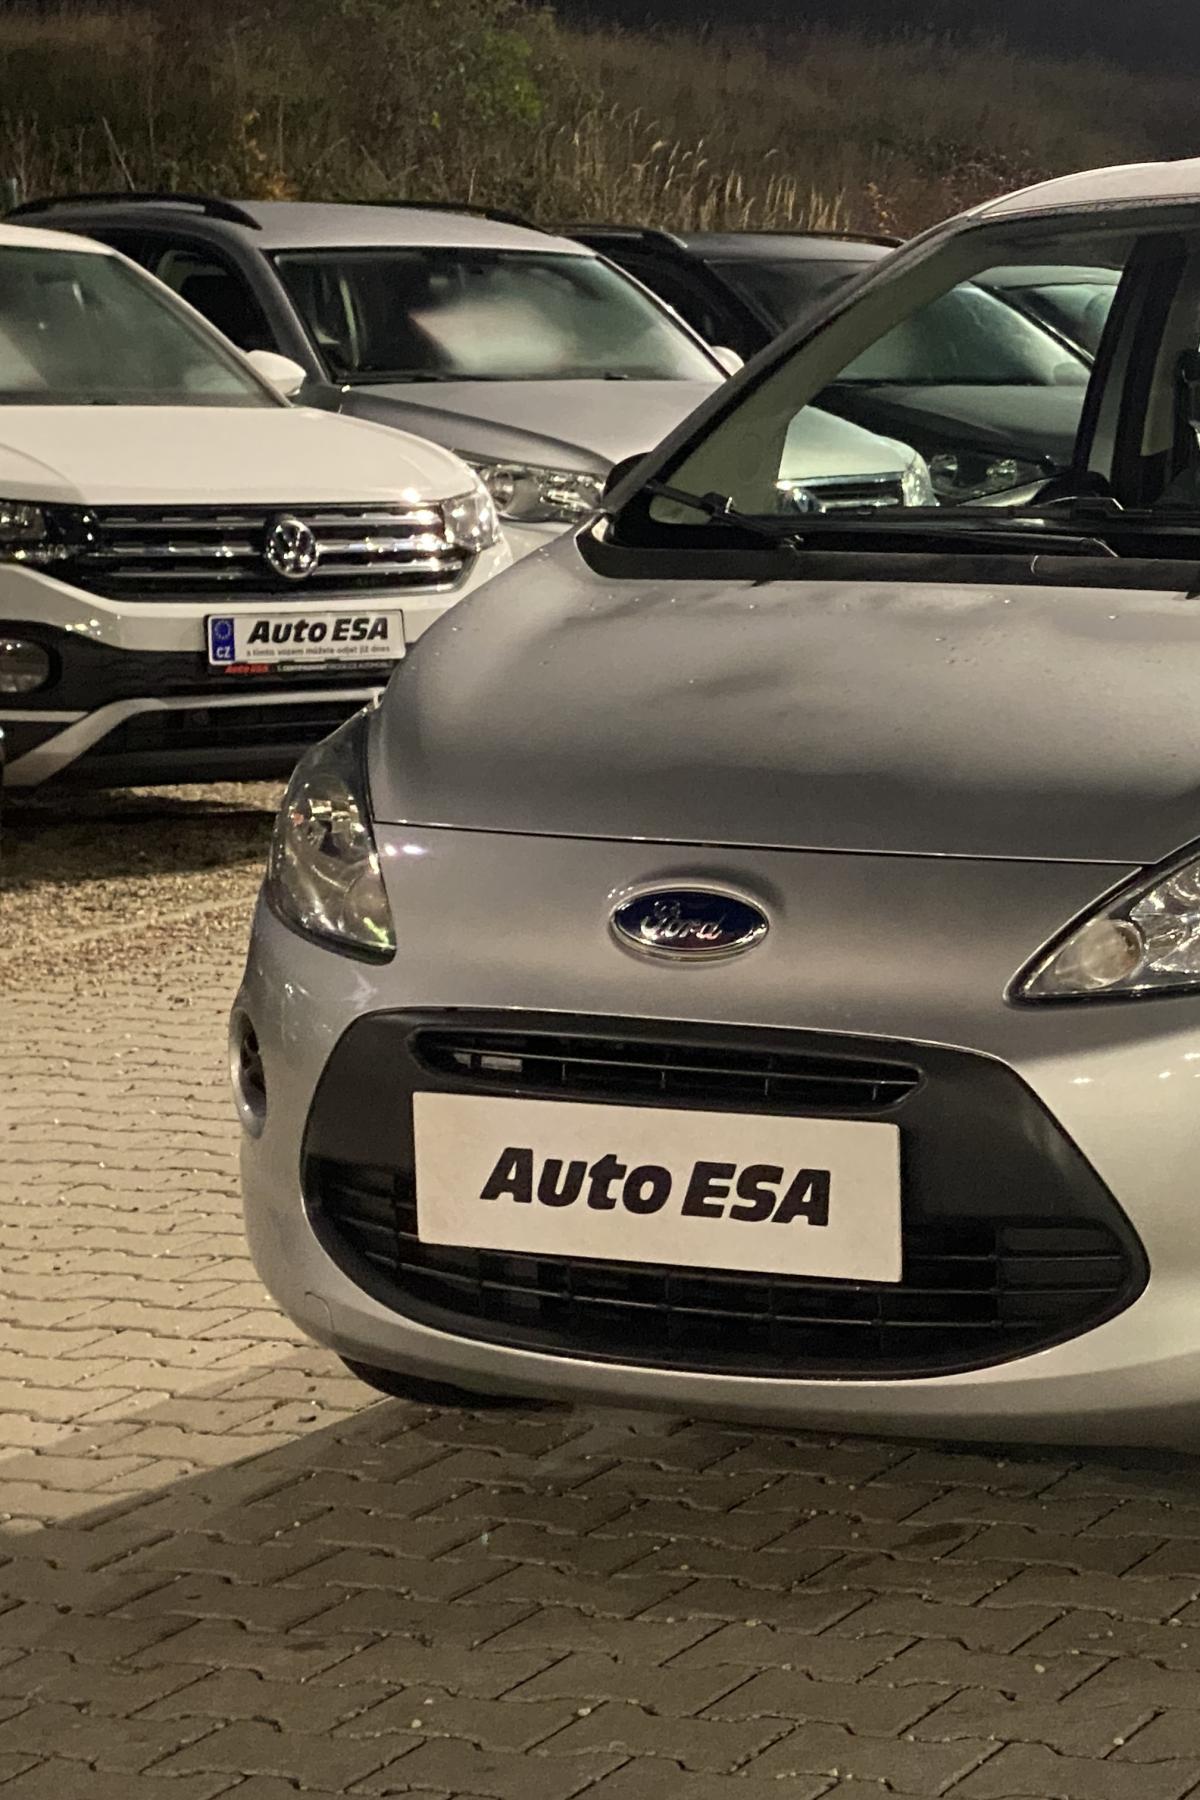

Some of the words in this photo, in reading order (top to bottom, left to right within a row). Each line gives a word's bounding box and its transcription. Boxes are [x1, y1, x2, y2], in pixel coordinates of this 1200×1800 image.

[247, 619, 327, 644] Auto
[331, 617, 388, 642] ESA
[216, 646, 231, 658] CZ
[480, 1146, 672, 1215] Auto
[681, 1160, 831, 1227] ESA
